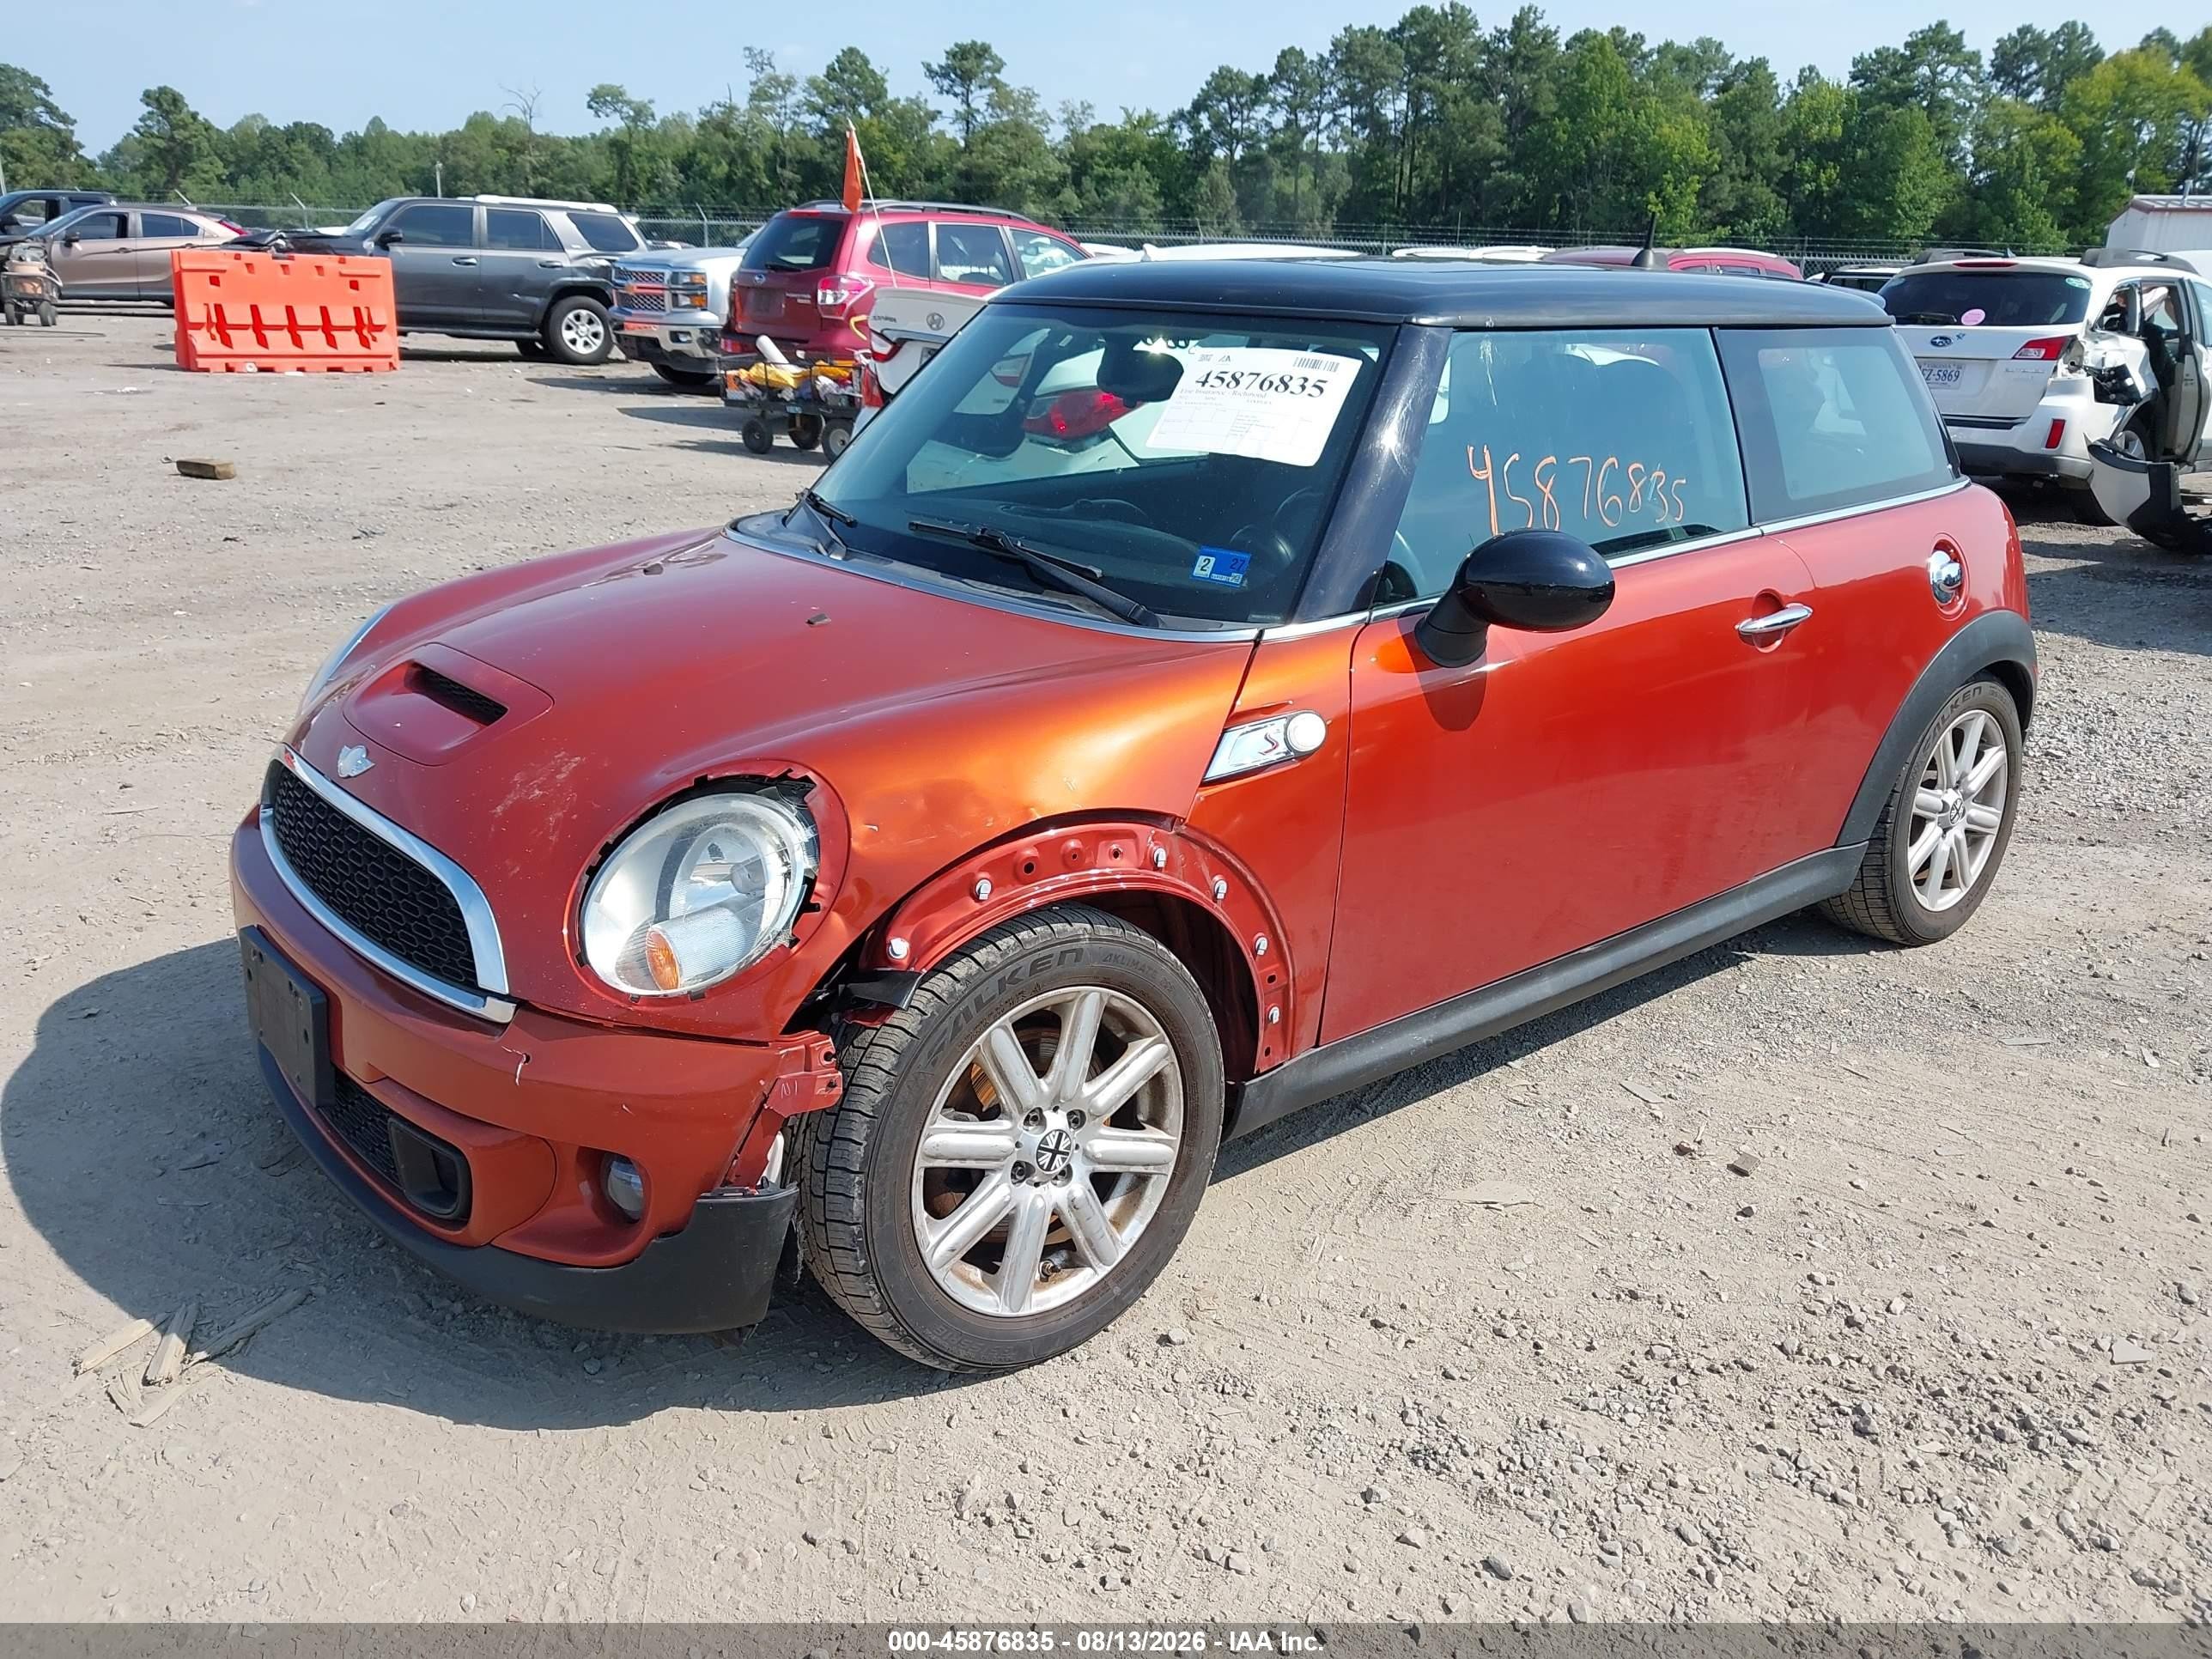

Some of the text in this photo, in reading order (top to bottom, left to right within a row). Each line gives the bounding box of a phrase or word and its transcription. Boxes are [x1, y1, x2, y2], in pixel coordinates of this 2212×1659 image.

[1195, 369, 1328, 398] 45876835
[1467, 444, 1686, 537] 45876835
[1200, 558, 1246, 572] 2 27
[925, 947, 1084, 1067] FALKEN
